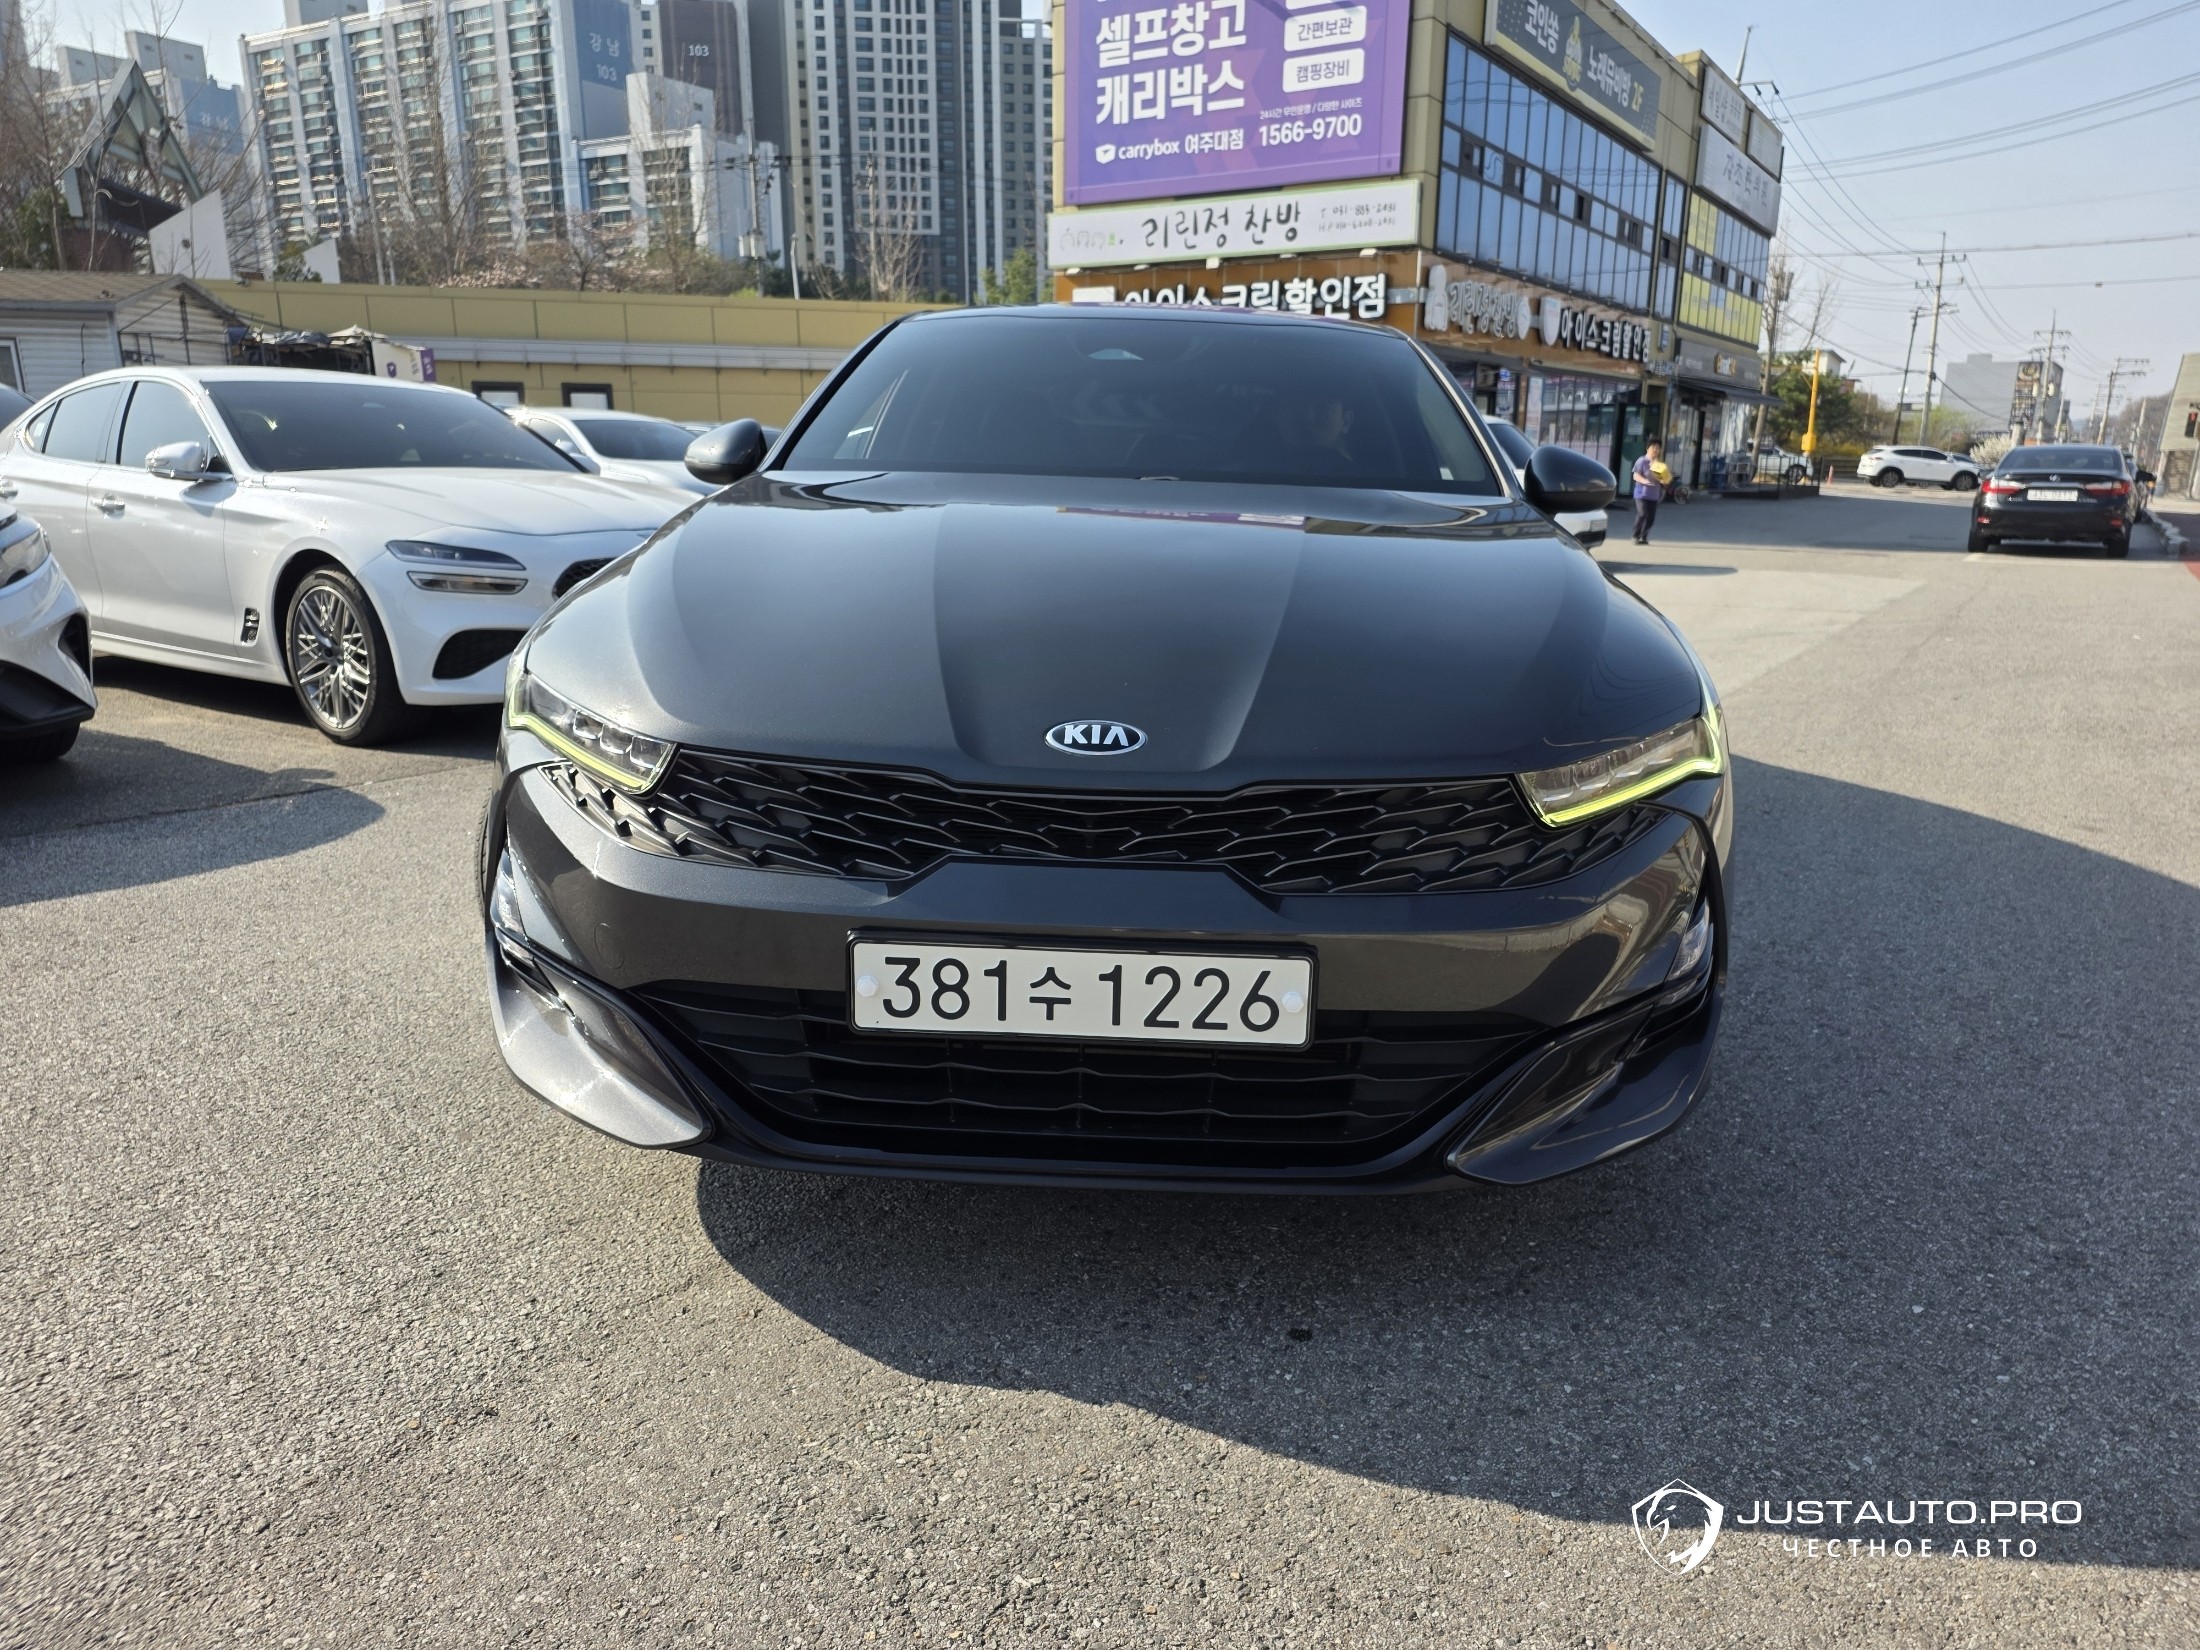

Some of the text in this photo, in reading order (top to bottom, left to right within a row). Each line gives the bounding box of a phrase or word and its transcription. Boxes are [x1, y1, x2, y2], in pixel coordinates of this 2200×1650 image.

[1096, 0, 1247, 68] 셀프창고
[1297, 17, 1352, 41] 간편보관
[688, 44, 710, 57] 103
[1296, 59, 1350, 83] 캠핑장비
[1096, 60, 1245, 125] 캐리박스
[1631, 80, 1644, 112] 2F
[1118, 128, 1244, 160] carrybox 여주대점
[1259, 113, 1362, 146] 1566-9700
[1560, 307, 1651, 364] 아이스크림할인점
[1063, 724, 1129, 747] KIA
